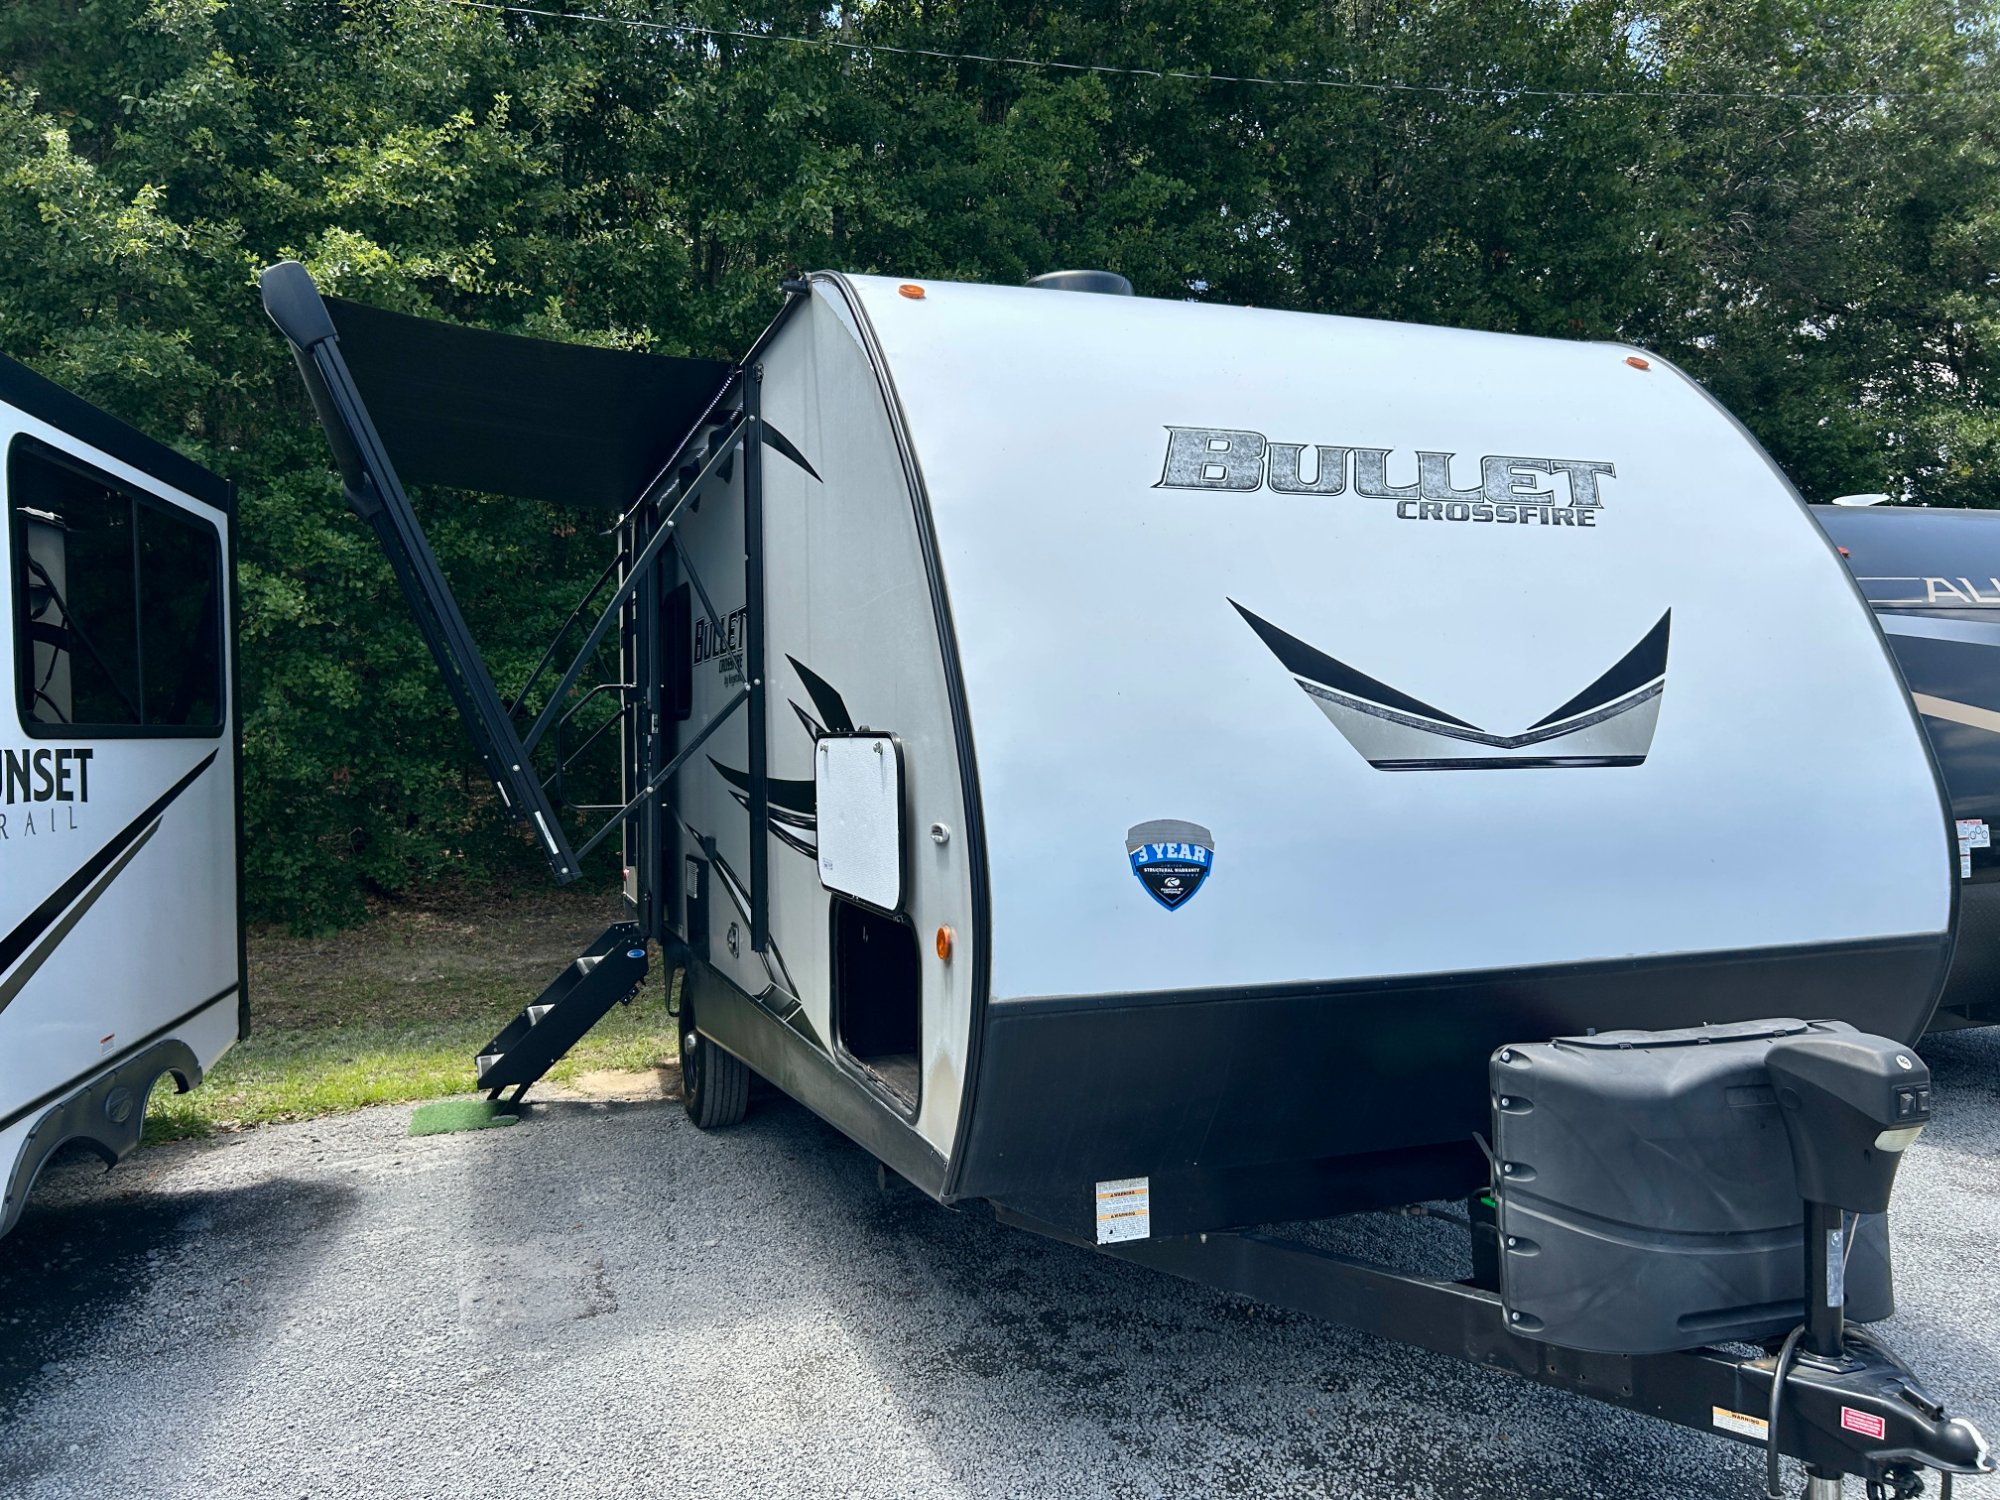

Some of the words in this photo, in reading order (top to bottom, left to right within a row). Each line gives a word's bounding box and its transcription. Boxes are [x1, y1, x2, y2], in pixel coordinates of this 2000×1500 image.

[1151, 424, 1617, 509] BULLET
[1396, 501, 1597, 527] CROSSFIRE
[0, 748, 93, 805] NSET
[1138, 845, 1149, 863] 3
[1152, 842, 1206, 863] YEAR
[1731, 1413, 1760, 1425] WARNING
